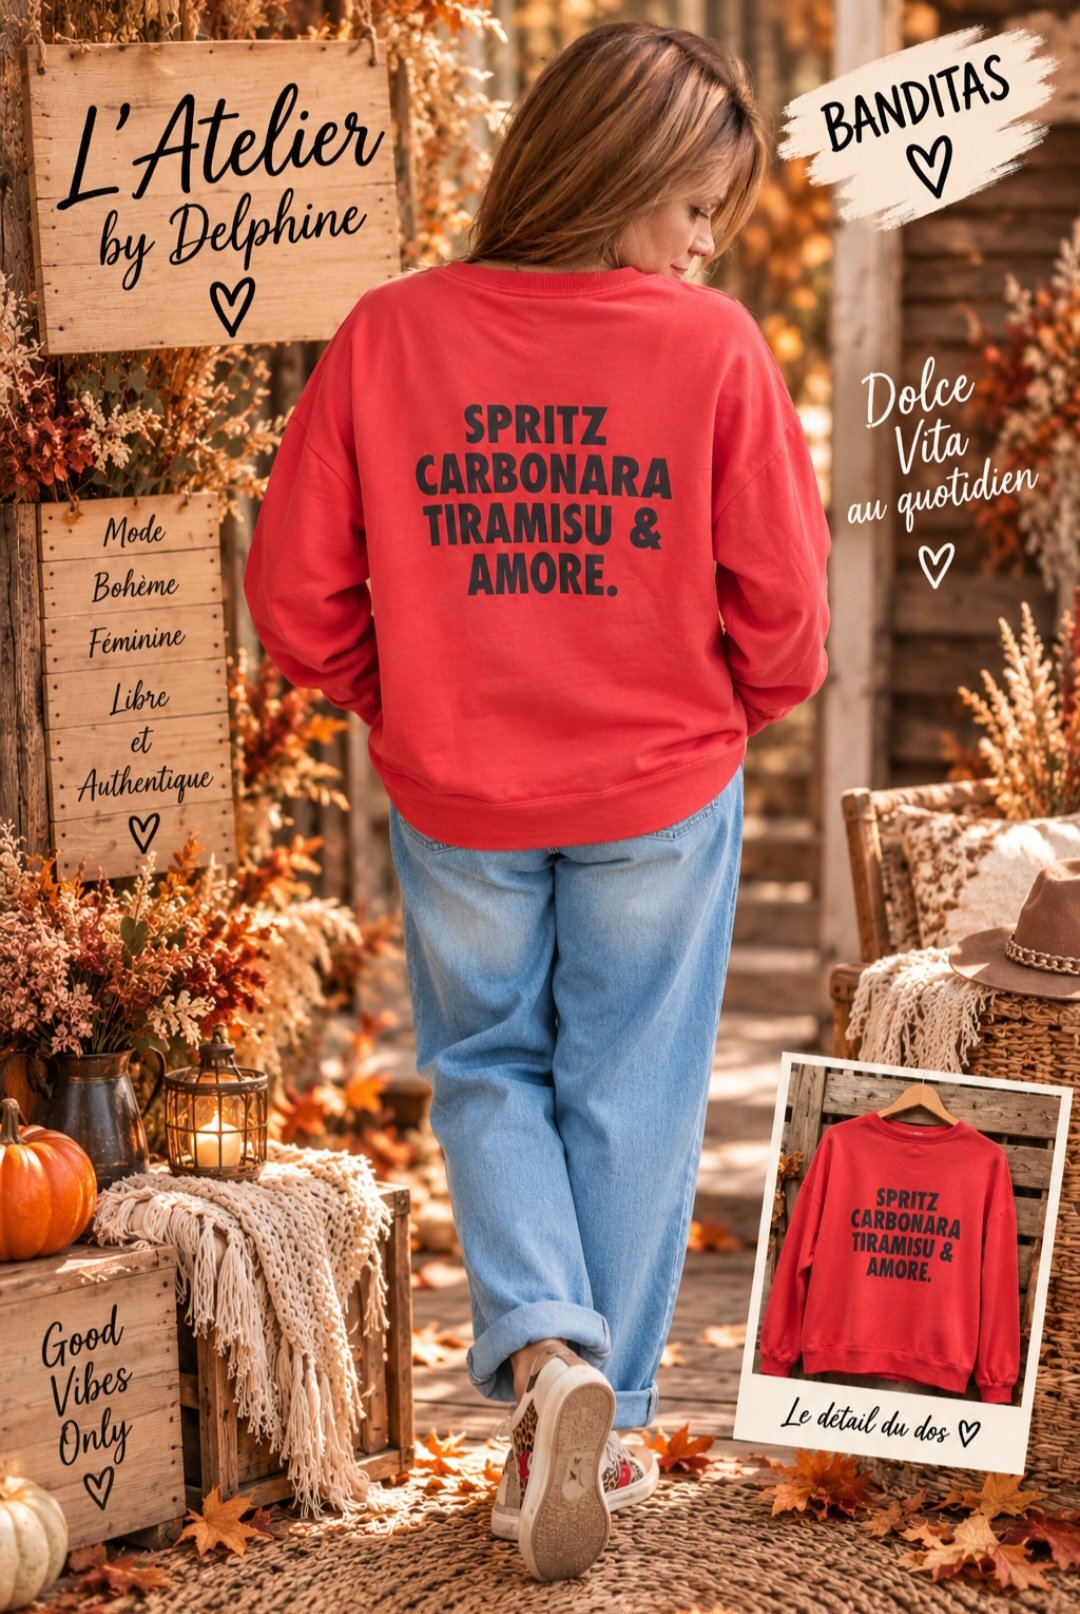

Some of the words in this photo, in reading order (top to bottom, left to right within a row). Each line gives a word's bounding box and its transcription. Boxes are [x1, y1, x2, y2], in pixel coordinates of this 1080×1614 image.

[56, 82, 386, 211] L'Atelier
[100, 209, 155, 291] by
[168, 187, 368, 271] Delphine
[463, 403, 608, 446] SPRITZ
[415, 452, 673, 500] CARBONARA
[103, 513, 167, 548] Mode
[422, 502, 613, 547] TIRAMISU
[629, 507, 662, 550] &
[91, 568, 180, 603] Bohème
[467, 551, 619, 597] AMORE.
[88, 626, 187, 658] Féminine
[109, 679, 171, 716] Libre
[130, 726, 155, 754] et
[77, 765, 214, 804] Authentique
[876, 1187, 940, 1212] SPRITZ
[850, 1208, 961, 1240] CARBONARA
[851, 1231, 935, 1258] TIRAMISU
[939, 1241, 954, 1263] &
[866, 1256, 932, 1283] AMORE.
[41, 1303, 124, 1368] Good
[50, 1361, 133, 1417] Vibes
[59, 1407, 133, 1466] Only
